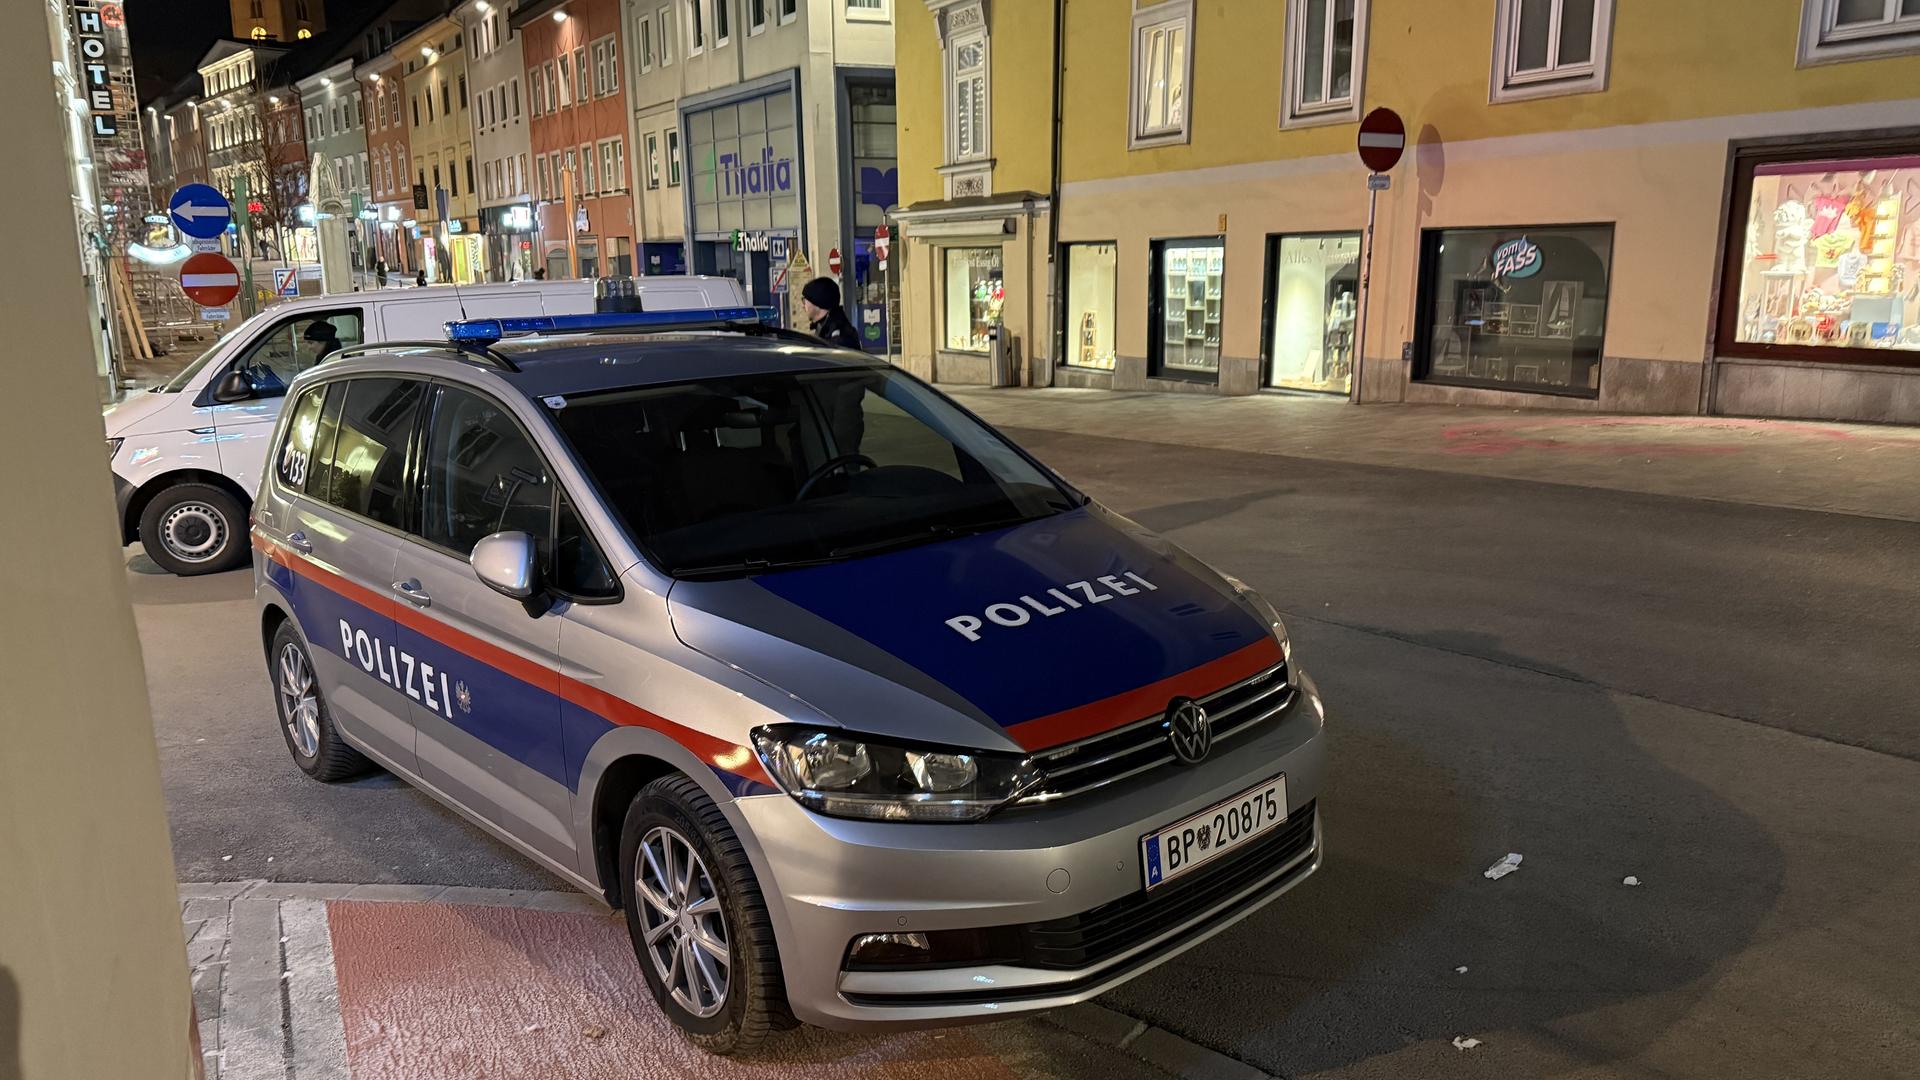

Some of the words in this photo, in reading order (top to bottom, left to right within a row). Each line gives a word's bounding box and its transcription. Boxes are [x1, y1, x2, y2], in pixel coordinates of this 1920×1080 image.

[80, 12, 115, 135] HOTEL
[720, 146, 791, 195] Thalia
[1494, 244, 1537, 279] FASS
[289, 450, 306, 485] 133
[944, 571, 1158, 642] POLIZEI
[339, 618, 453, 719] POLIZEI
[1167, 828, 1195, 870] BP
[1213, 787, 1277, 849] 20875
[1151, 865, 1159, 879] A
